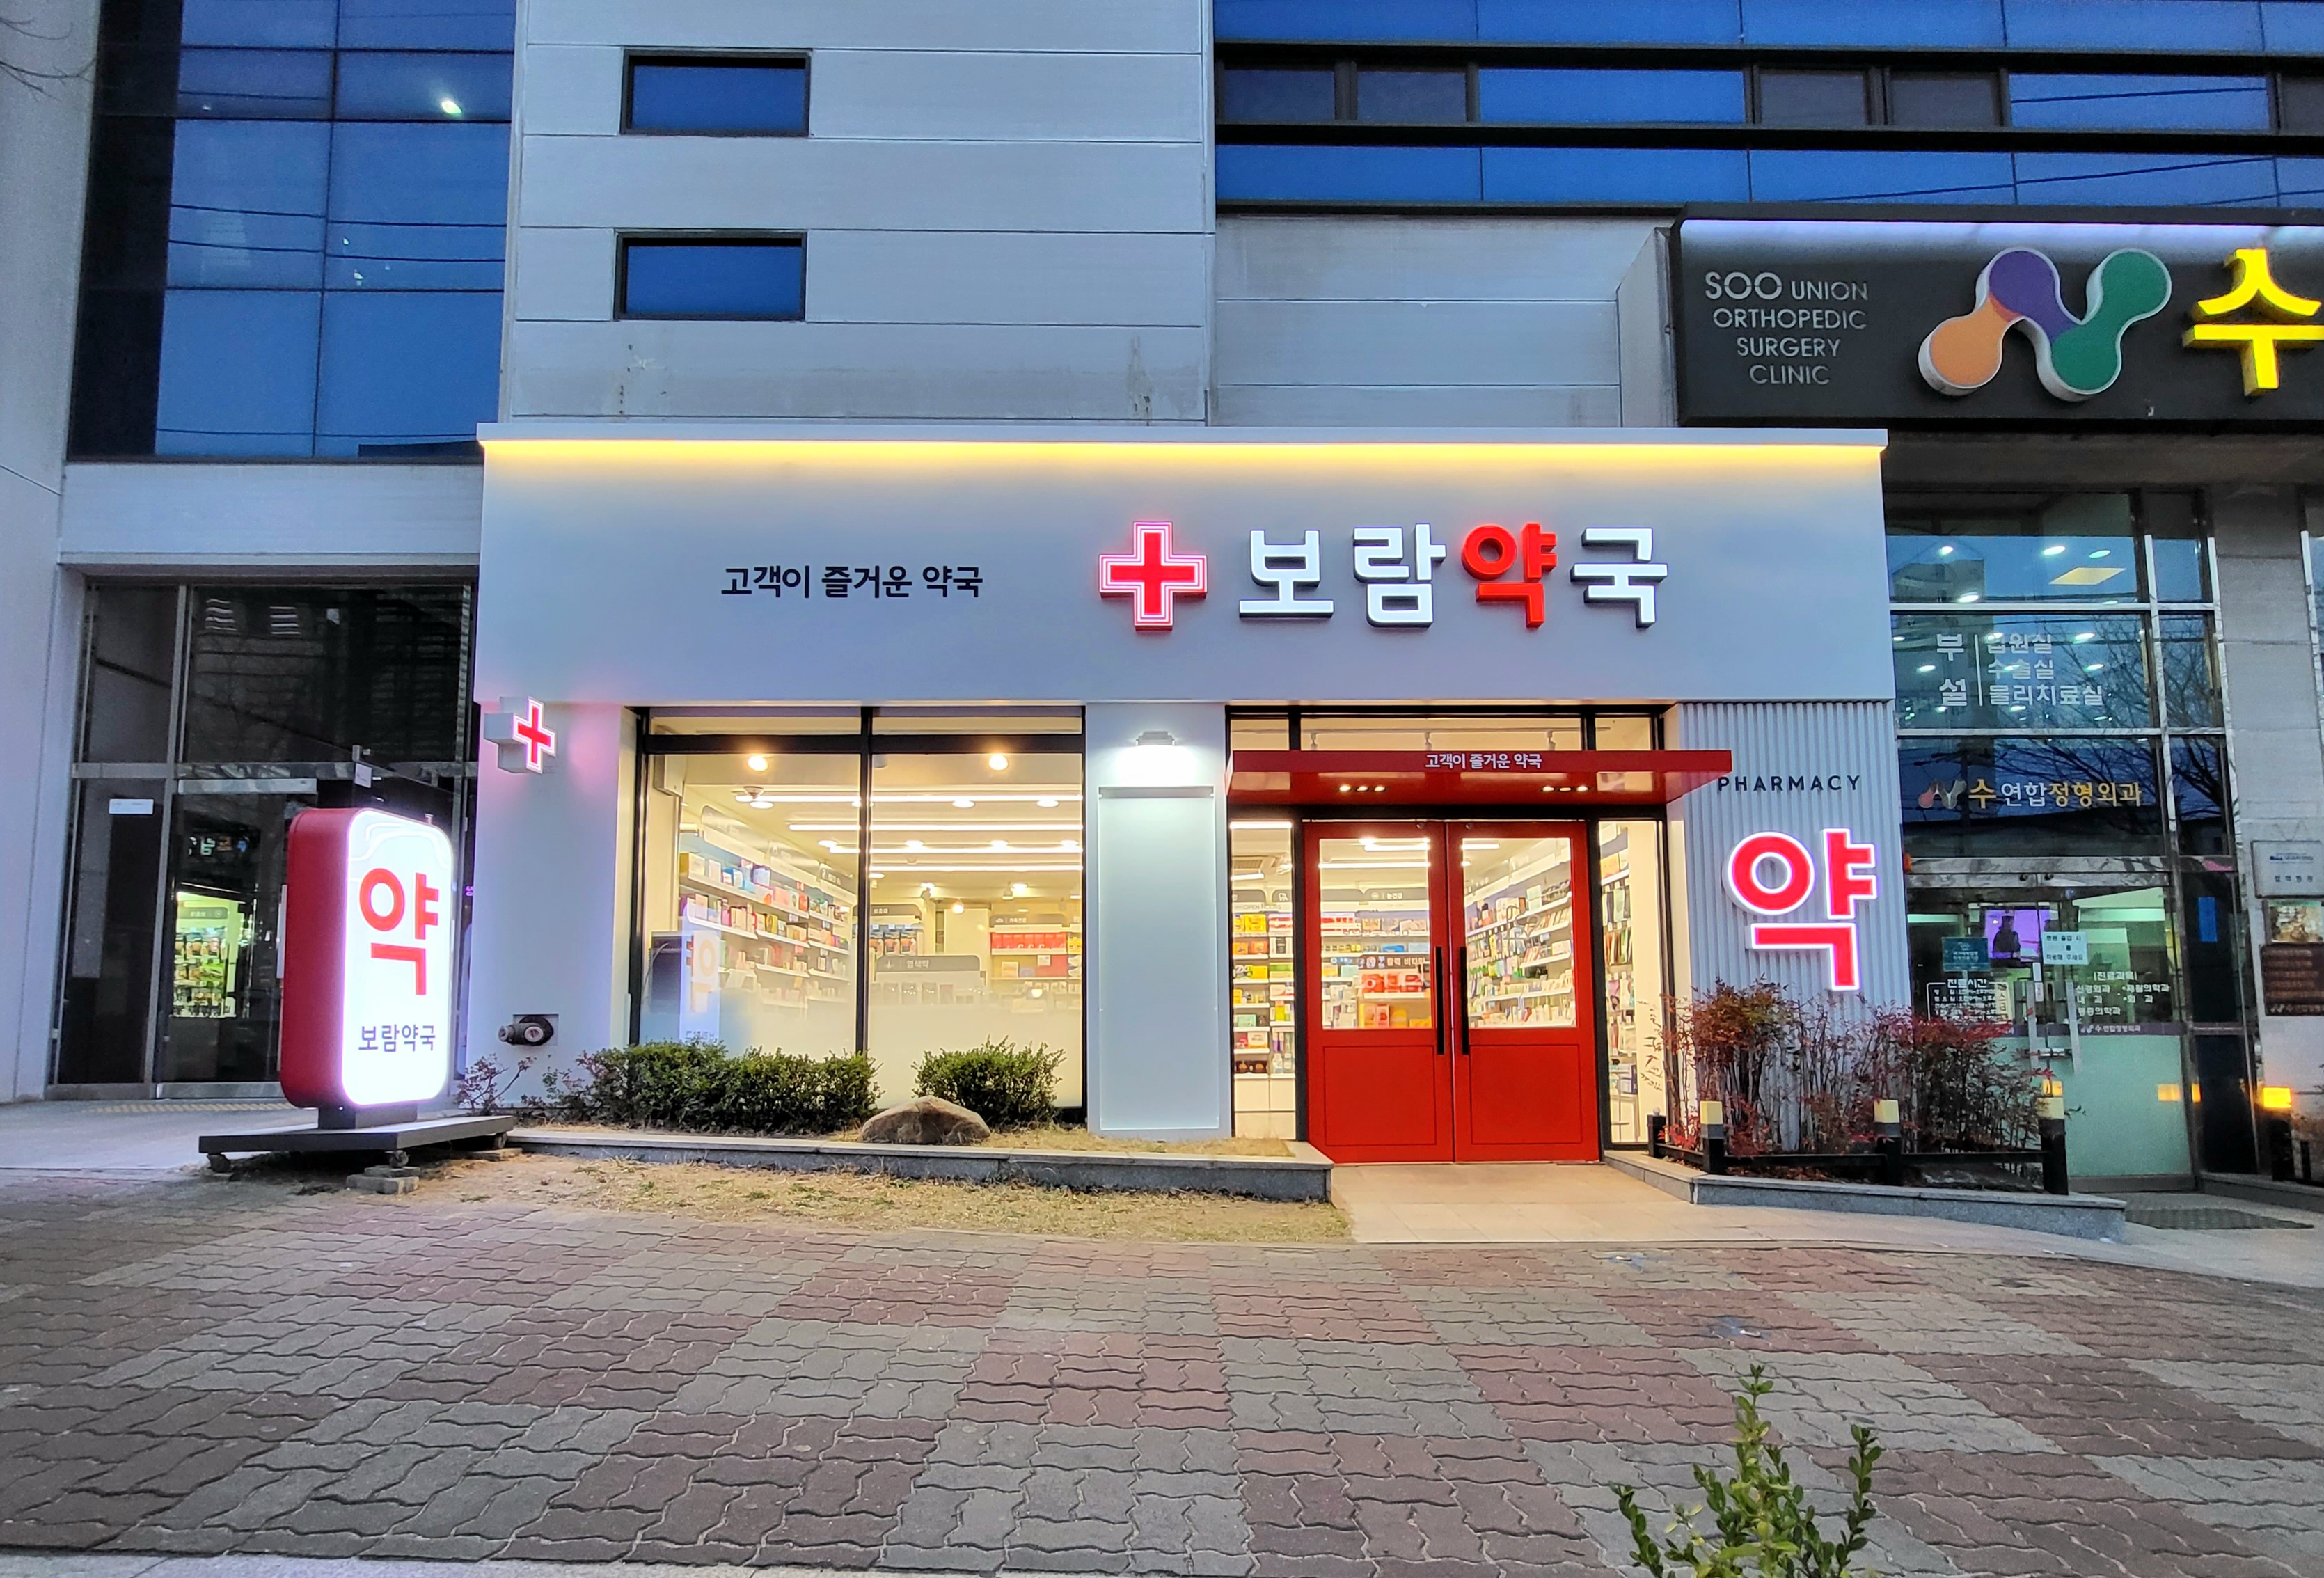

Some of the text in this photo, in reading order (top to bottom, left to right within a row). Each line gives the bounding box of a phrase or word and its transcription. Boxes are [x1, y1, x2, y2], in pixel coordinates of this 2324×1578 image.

[1705, 271, 1868, 301] SOO UNION
[1712, 308, 1867, 331] ORTHOPEDIC
[2181, 248, 2324, 397] 수
[1737, 336, 1841, 358] SURGERY
[1749, 365, 1831, 385] CLINIC
[721, 565, 983, 598] 고객이 즐거운 약국
[1238, 521, 1670, 629] 보람약국
[1987, 658, 2054, 679] 수술실
[1989, 684, 2103, 706] 물리치료실
[1425, 753, 1542, 769] 고객이 즐거운 약국
[1718, 775, 1861, 791] PHARMACY
[1722, 828, 1878, 991] 약
[359, 867, 439, 995] 약
[1947, 979, 1988, 988] 진료시간
[358, 1024, 436, 1052] 보람약국
